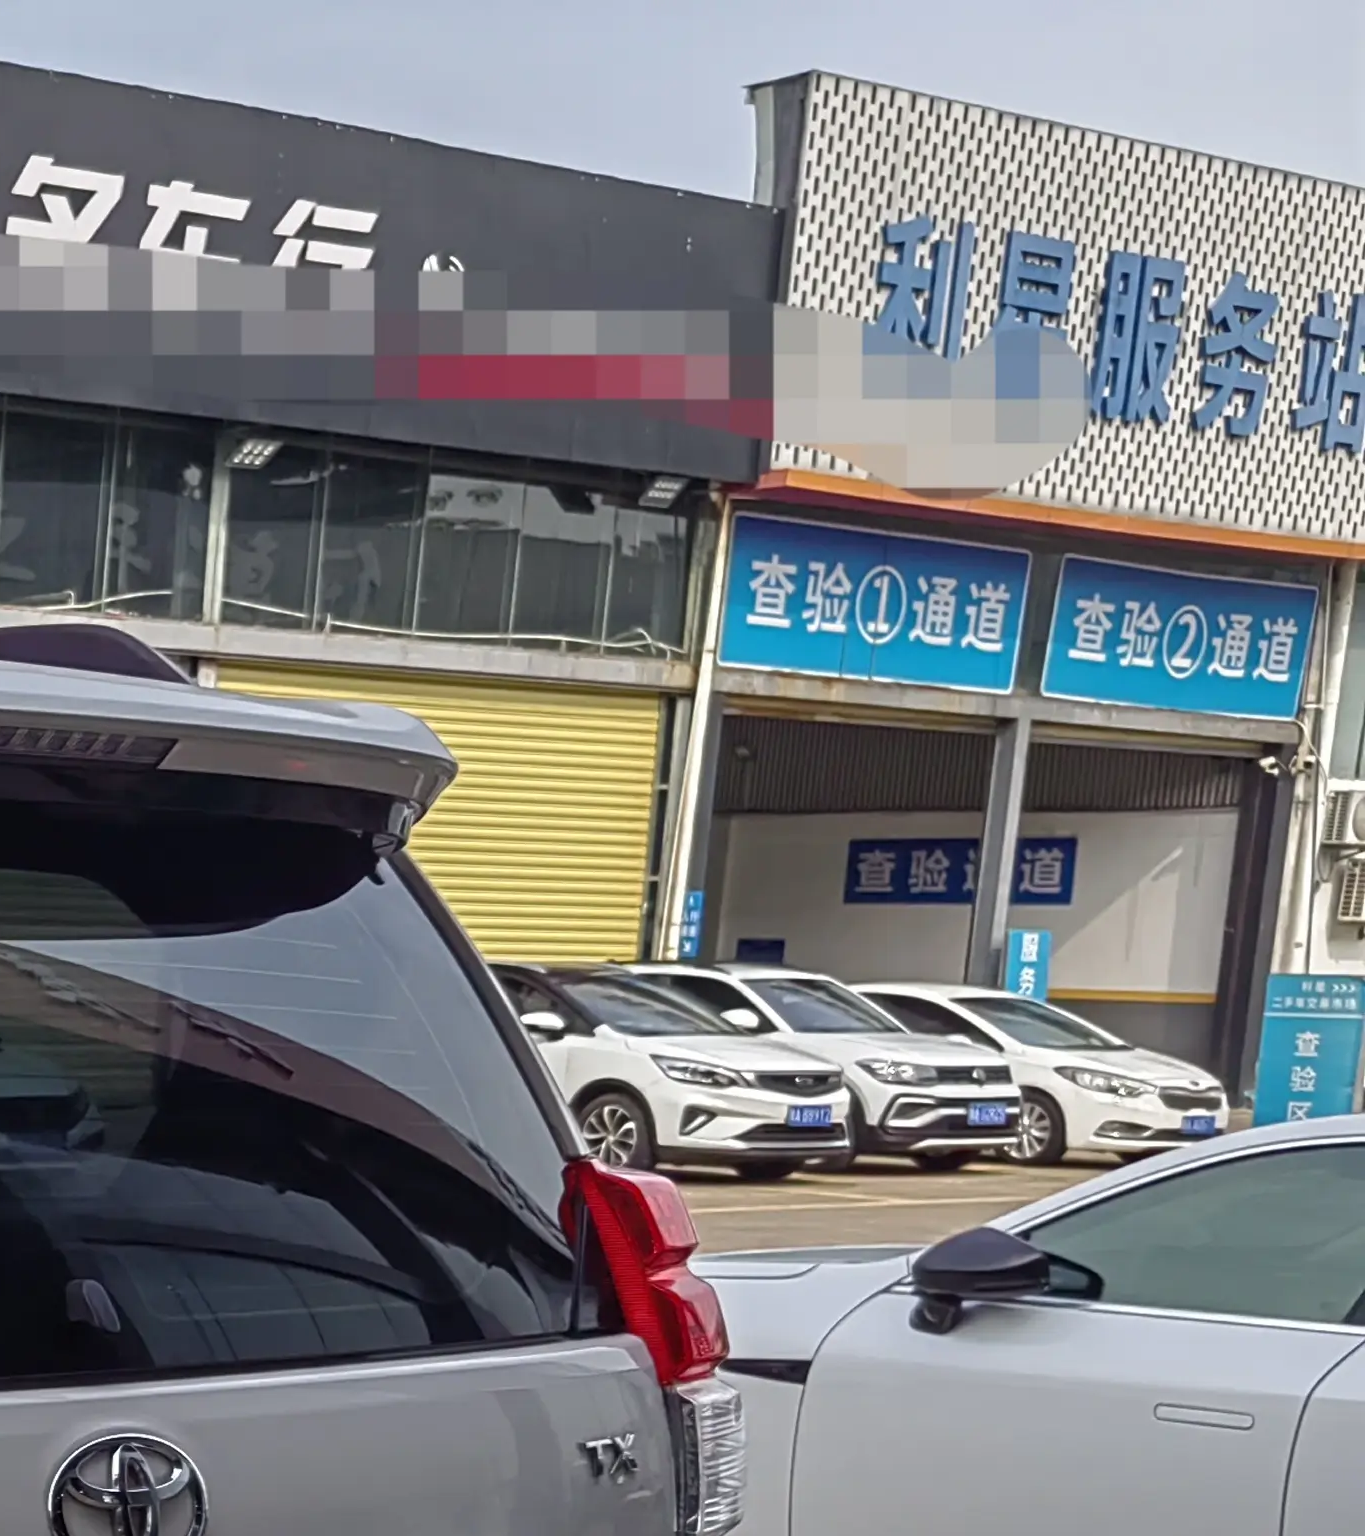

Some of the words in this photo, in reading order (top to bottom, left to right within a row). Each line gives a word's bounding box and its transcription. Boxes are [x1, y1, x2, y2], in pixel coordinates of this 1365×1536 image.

[1287, 1030, 1320, 1121] 查验区
[577, 1433, 639, 1480] TX
